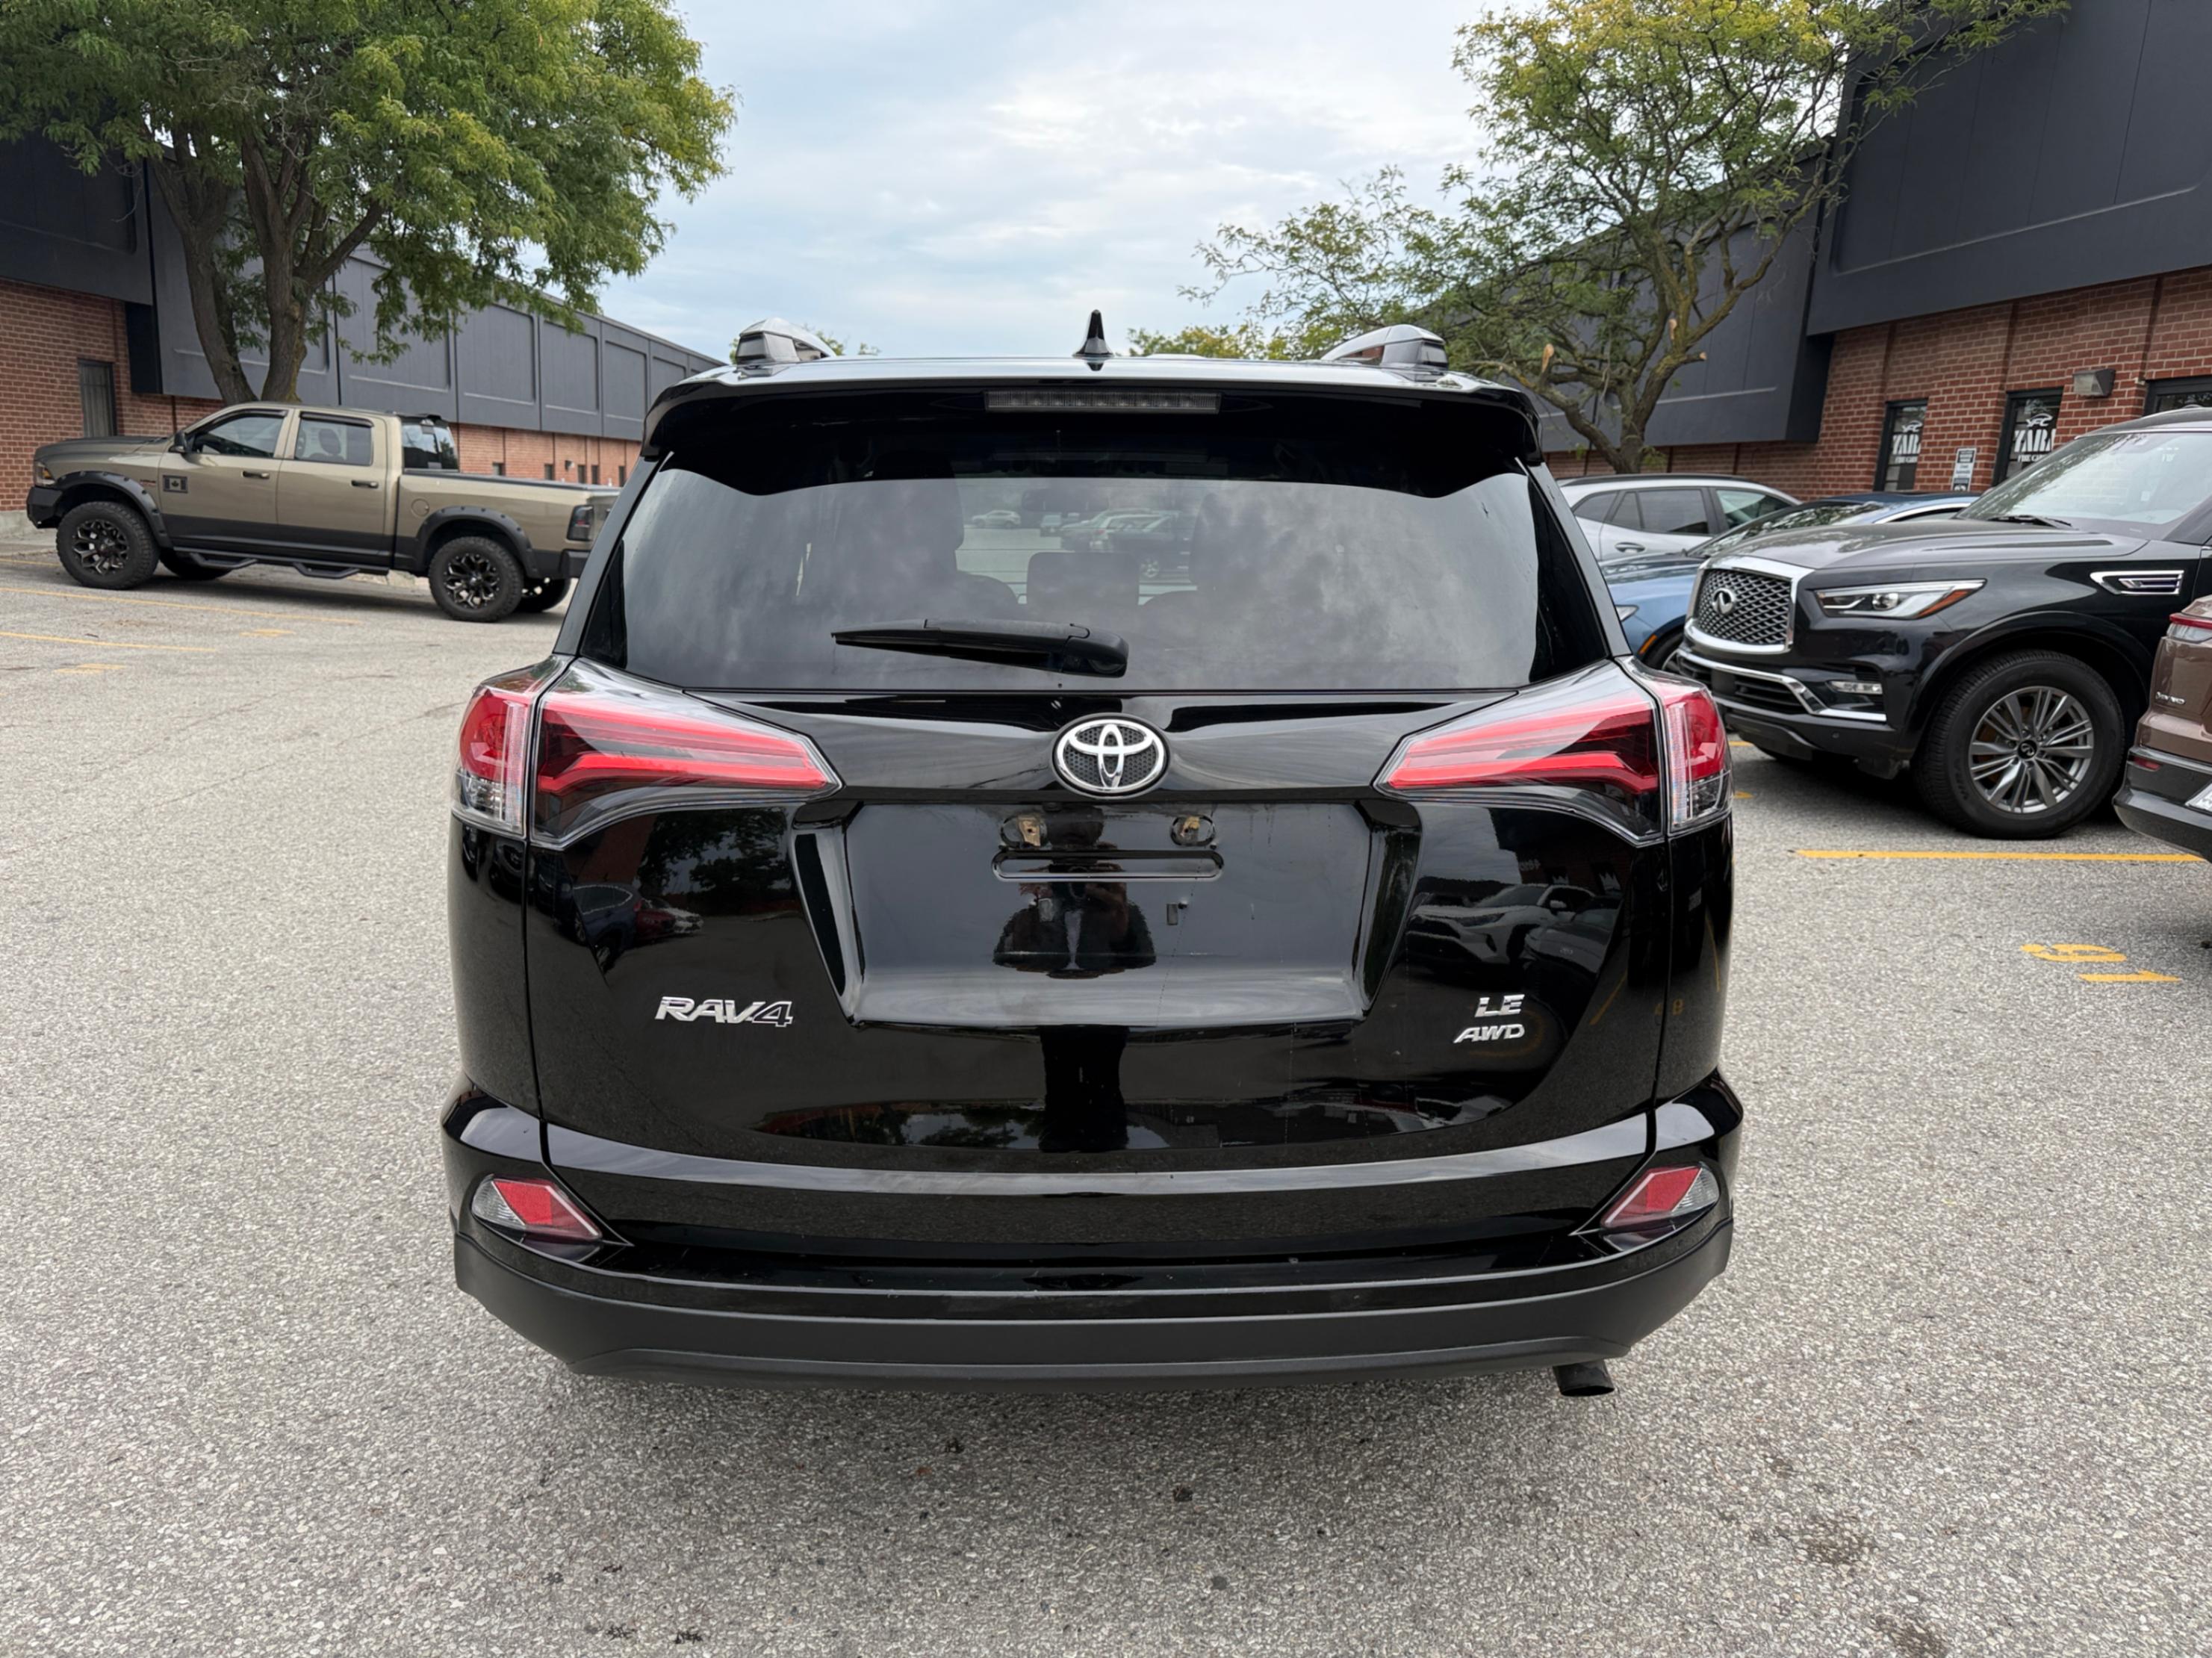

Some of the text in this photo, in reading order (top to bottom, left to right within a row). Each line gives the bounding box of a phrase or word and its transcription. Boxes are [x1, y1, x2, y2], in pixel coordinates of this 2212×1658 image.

[654, 996, 793, 1028] RAV4
[1474, 994, 1525, 1018] LE
[1453, 1024, 1525, 1043] AWD
